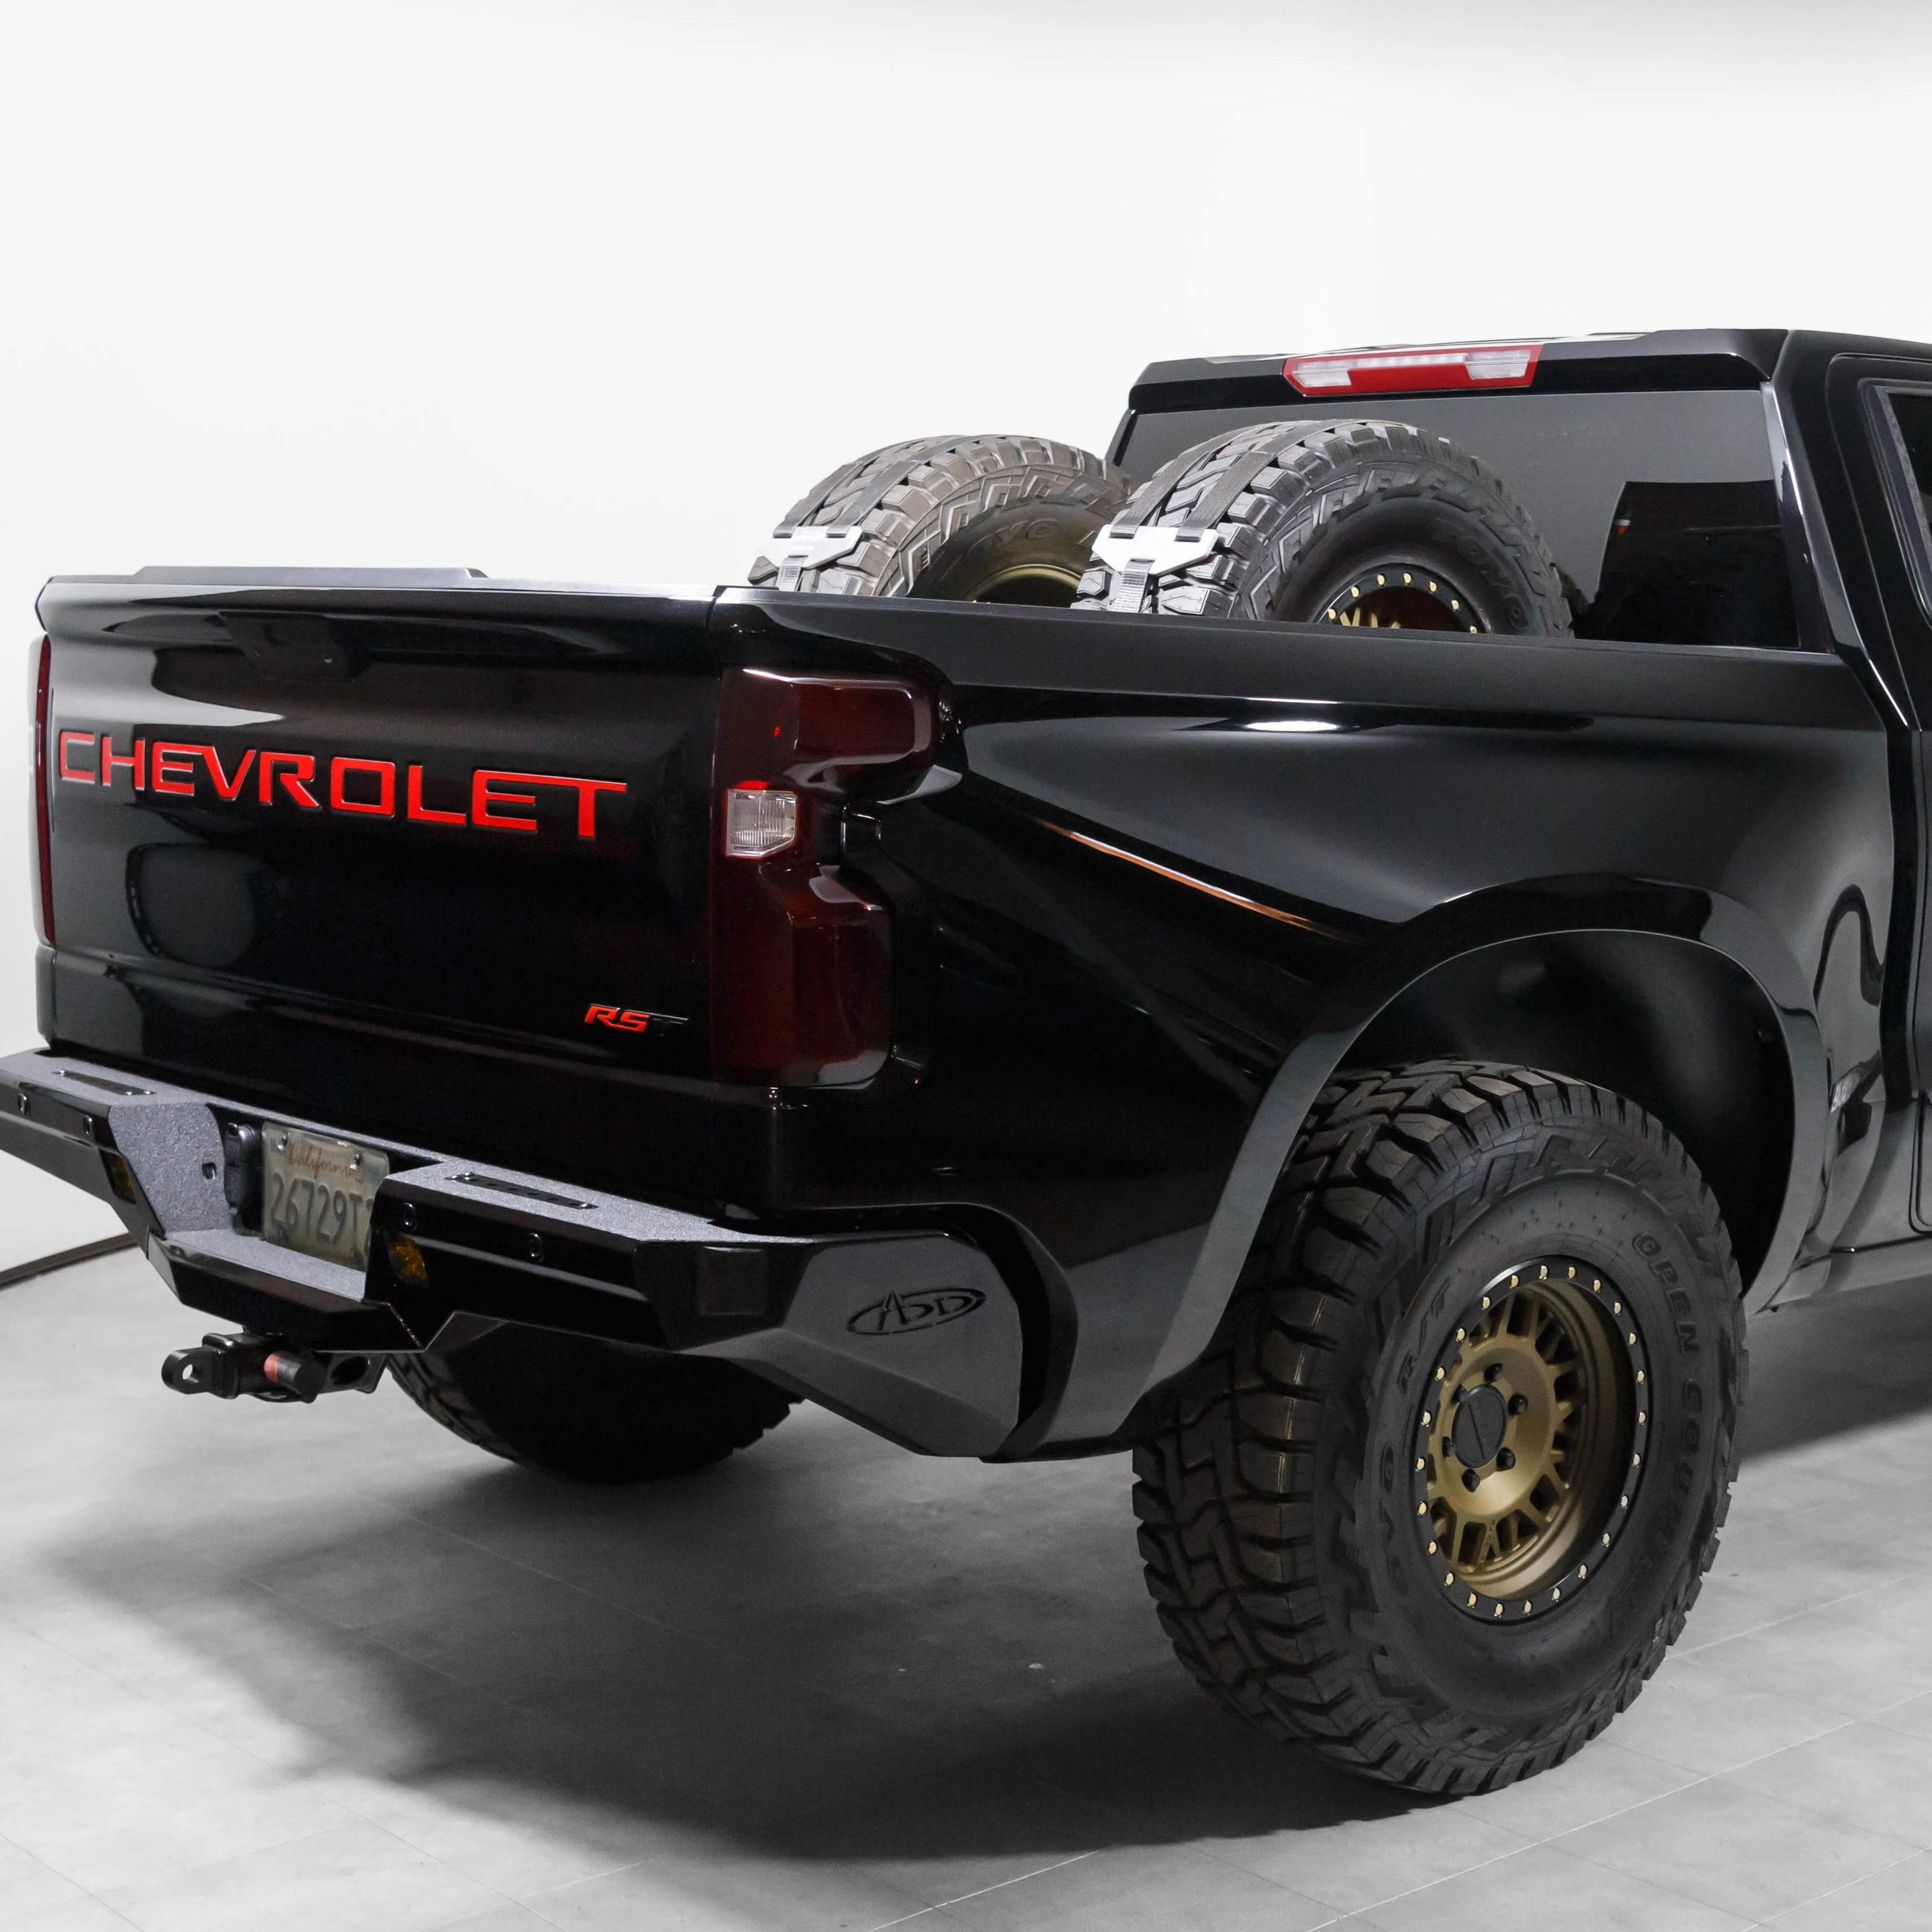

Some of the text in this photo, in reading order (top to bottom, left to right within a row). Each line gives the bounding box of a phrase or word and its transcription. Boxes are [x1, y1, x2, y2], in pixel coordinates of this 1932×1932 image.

[1431, 517, 1529, 631] TOYO
[59, 729, 627, 838] CHEVROLET
[270, 1171, 373, 1253] 26729T
[288, 1139, 363, 1182] California
[1632, 1231, 1700, 1354] OPEN
